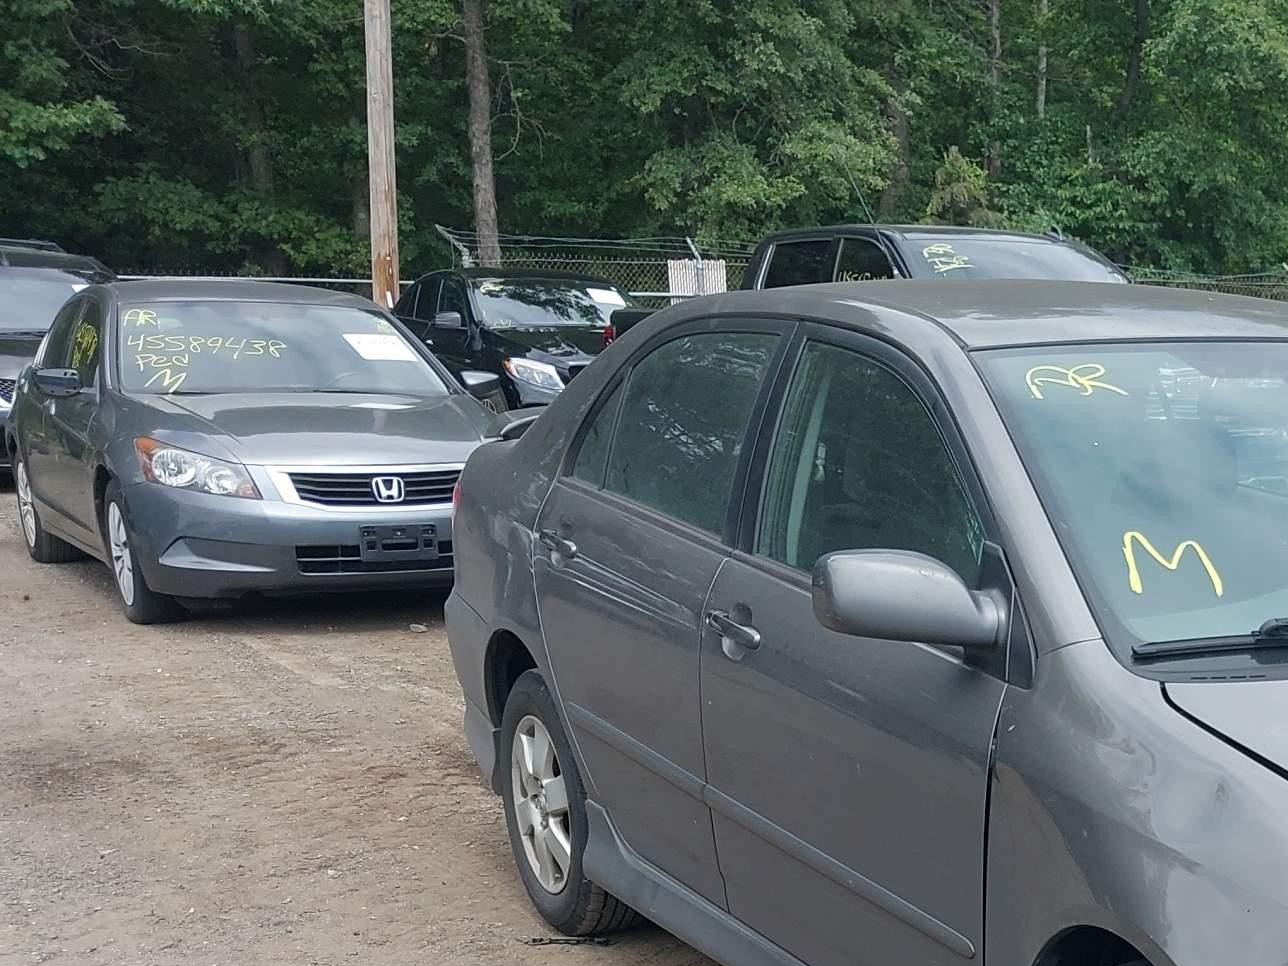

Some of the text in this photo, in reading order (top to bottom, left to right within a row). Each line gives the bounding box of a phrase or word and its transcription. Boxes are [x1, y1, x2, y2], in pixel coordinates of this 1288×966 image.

[127, 334, 288, 359] 45589438
[144, 368, 187, 393] M
[1121, 531, 1224, 598] M
